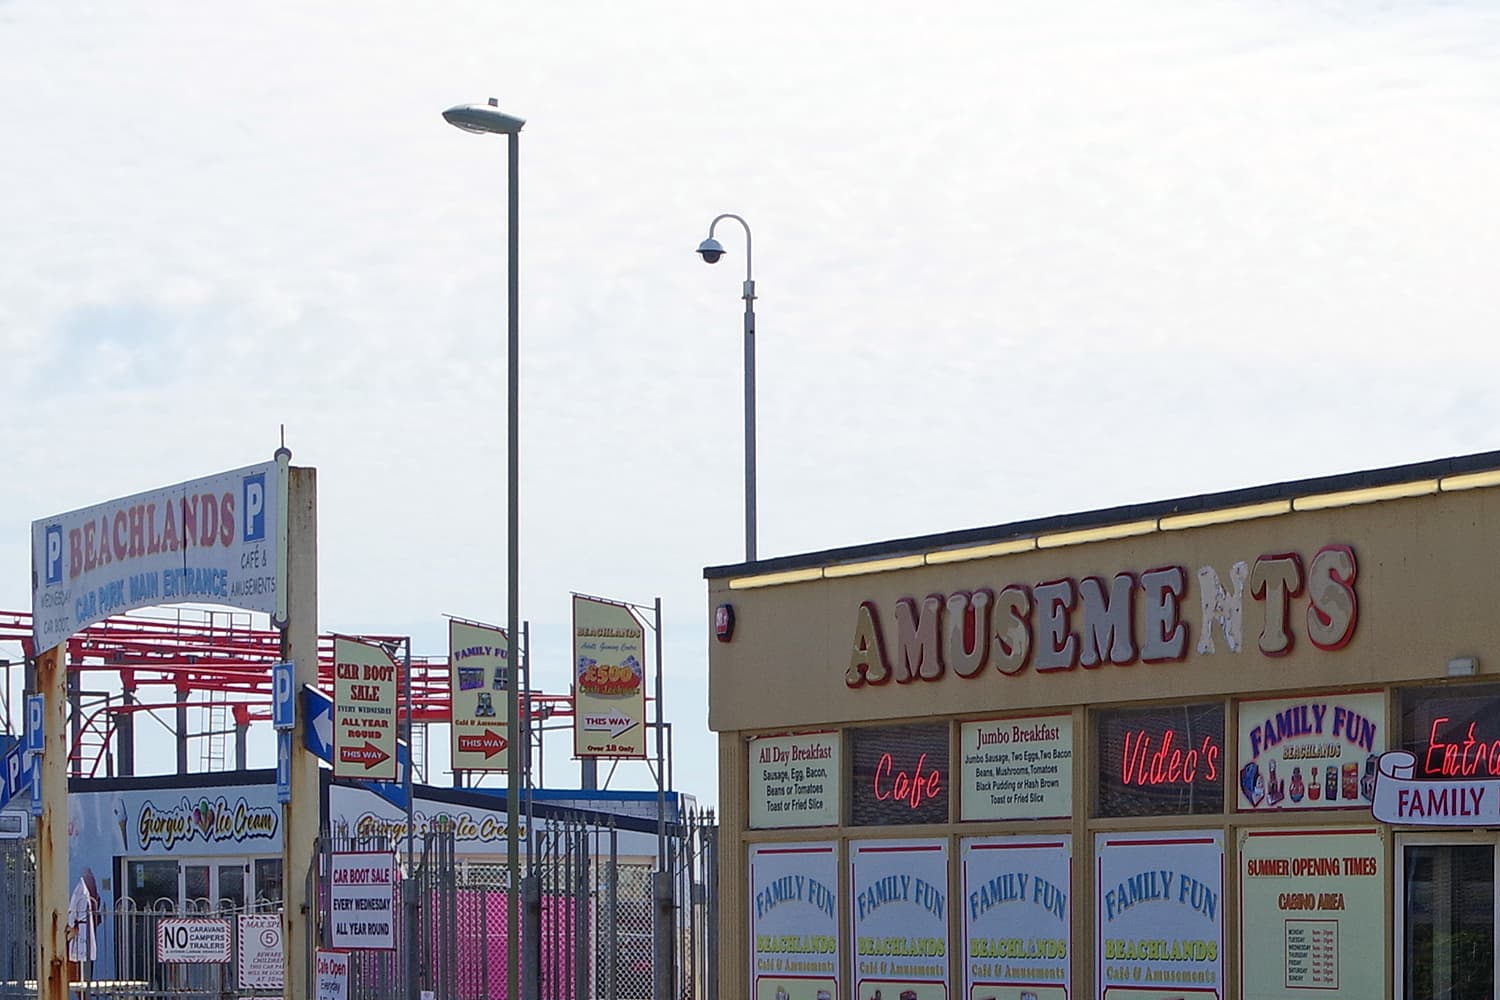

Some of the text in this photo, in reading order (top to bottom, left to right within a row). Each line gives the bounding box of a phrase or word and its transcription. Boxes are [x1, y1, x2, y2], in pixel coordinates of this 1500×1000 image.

[247, 482, 262, 536] P
[69, 493, 234, 578] BEACHLANDS
[49, 530, 60, 578] P
[76, 591, 97, 624] CAR
[98, 579, 125, 615] PARK
[129, 571, 158, 602] MAIN
[163, 567, 228, 597] ENTRANCE
[230, 576, 276, 597] AMUSEMENTS
[845, 543, 1360, 689] AMUSEMENTS
[577, 626, 641, 639] BEACHLANDS
[455, 646, 492, 661] FAMILY
[337, 663, 394, 681] CAR BOOT
[585, 664, 633, 685] £500
[276, 669, 290, 721] P
[351, 684, 379, 701] SALE
[338, 705, 392, 715] EVERY WEDNESDAY
[31, 700, 41, 745] P
[342, 718, 388, 728] ALL YEAR
[585, 717, 631, 726] THIS WAY
[1250, 703, 1376, 759] FAMILY FUN
[348, 730, 382, 739] ROUND
[976, 723, 1060, 750] Jumbo Breakfast
[342, 750, 382, 759] THIS WAY
[605, 744, 617, 752] 18
[618, 745, 634, 753] Only
[759, 744, 832, 766] All Day Breakfast
[1121, 729, 1219, 786] Video's
[1283, 744, 1341, 760] BEACHLANDS
[767, 785, 785, 796] Beans
[794, 783, 823, 795] Tomatoes
[873, 752, 941, 809] Cafe
[976, 781, 991, 791] Black
[992, 779, 1015, 792] Pudding
[1024, 779, 1039, 789] Hash
[1040, 778, 1059, 788] Brown
[767, 801, 783, 812] Toast
[792, 799, 807, 811] Fried
[808, 797, 823, 809] Slice
[1398, 786, 1485, 817] FAMILY
[139, 797, 272, 842] Giorgio's Ice Cream
[333, 868, 389, 884] CAR BOOT SALE
[1247, 857, 1377, 877] SUMMER OPENING TIMES
[333, 899, 391, 911] EVERY WEDNESDAY
[756, 874, 835, 920] FAMILY FUN
[1105, 870, 1217, 922] FAMILY FUN
[1278, 893, 1345, 911] CASINO AREA
[164, 926, 188, 949] NO
[265, 933, 274, 944] 5
[336, 923, 389, 935] ALL YEAR ROUND
[757, 934, 836, 954] BEACHLANDS
[1105, 939, 1217, 961] BEACHLANDS
[329, 959, 346, 979] Open
